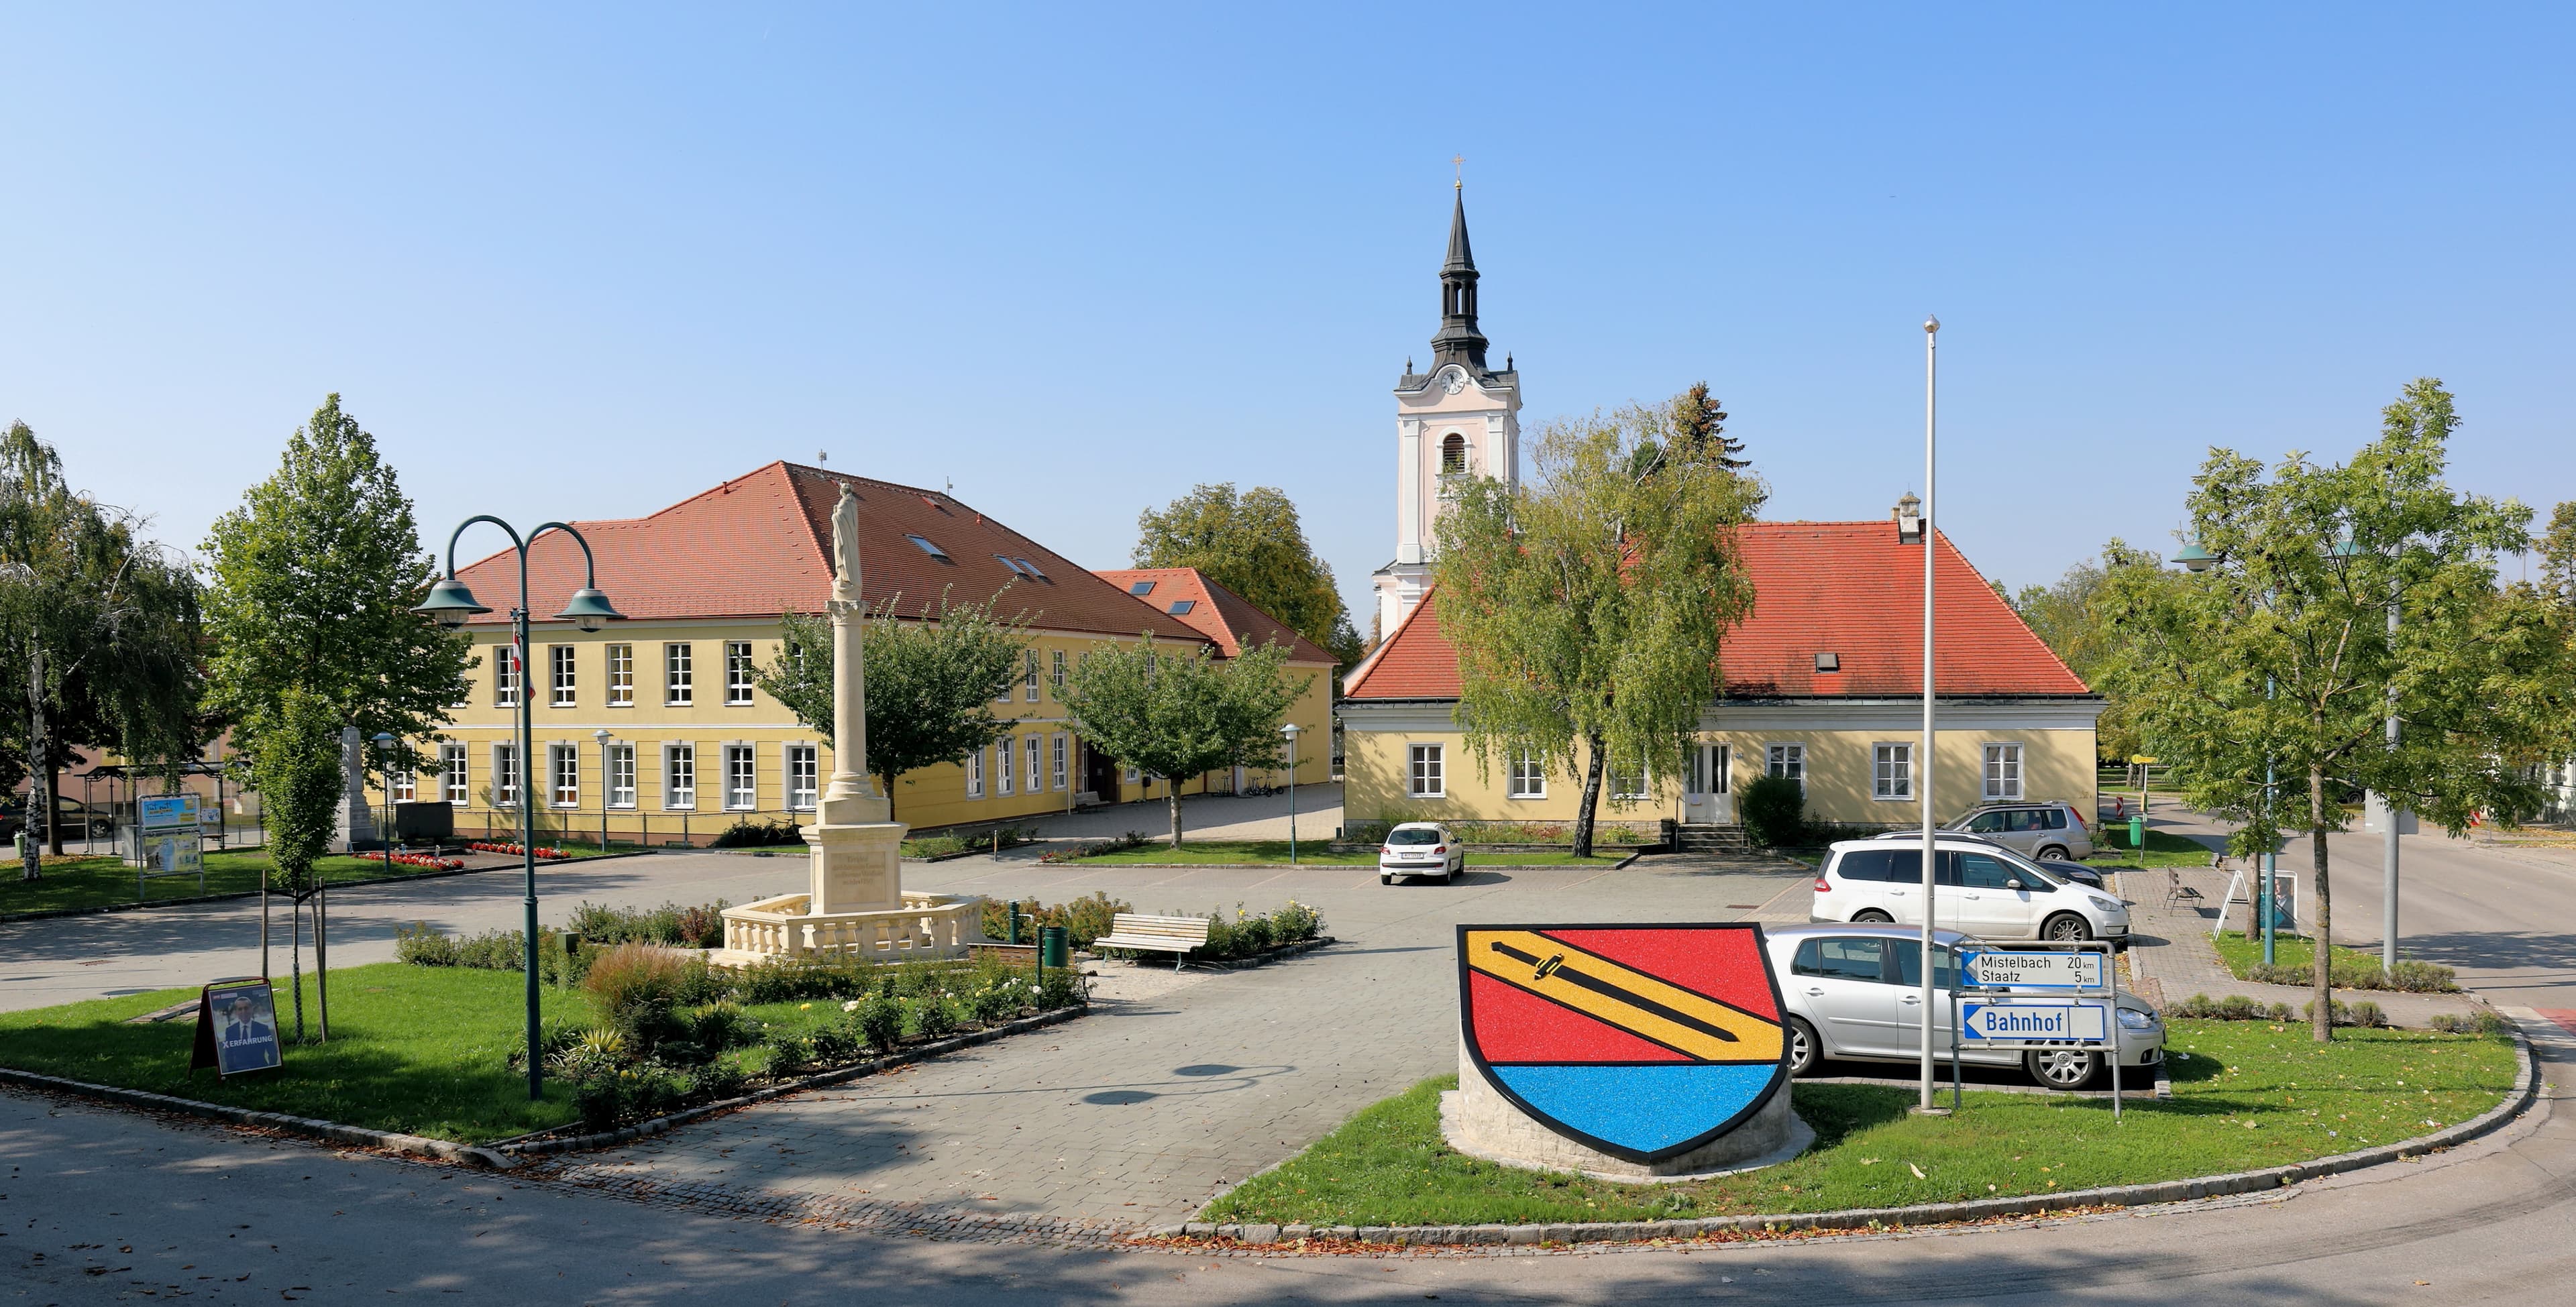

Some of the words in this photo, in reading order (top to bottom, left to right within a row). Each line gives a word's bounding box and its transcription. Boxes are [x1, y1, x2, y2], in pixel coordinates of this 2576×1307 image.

[1981, 956, 2051, 968] Mistelbach
[2067, 957, 2081, 969] 20
[1982, 970, 2021, 982] Staatz
[2075, 971, 2082, 982] 5
[1986, 1012, 2061, 1031] Bahnhof
[229, 1035, 272, 1047] ERFAHRUNG
